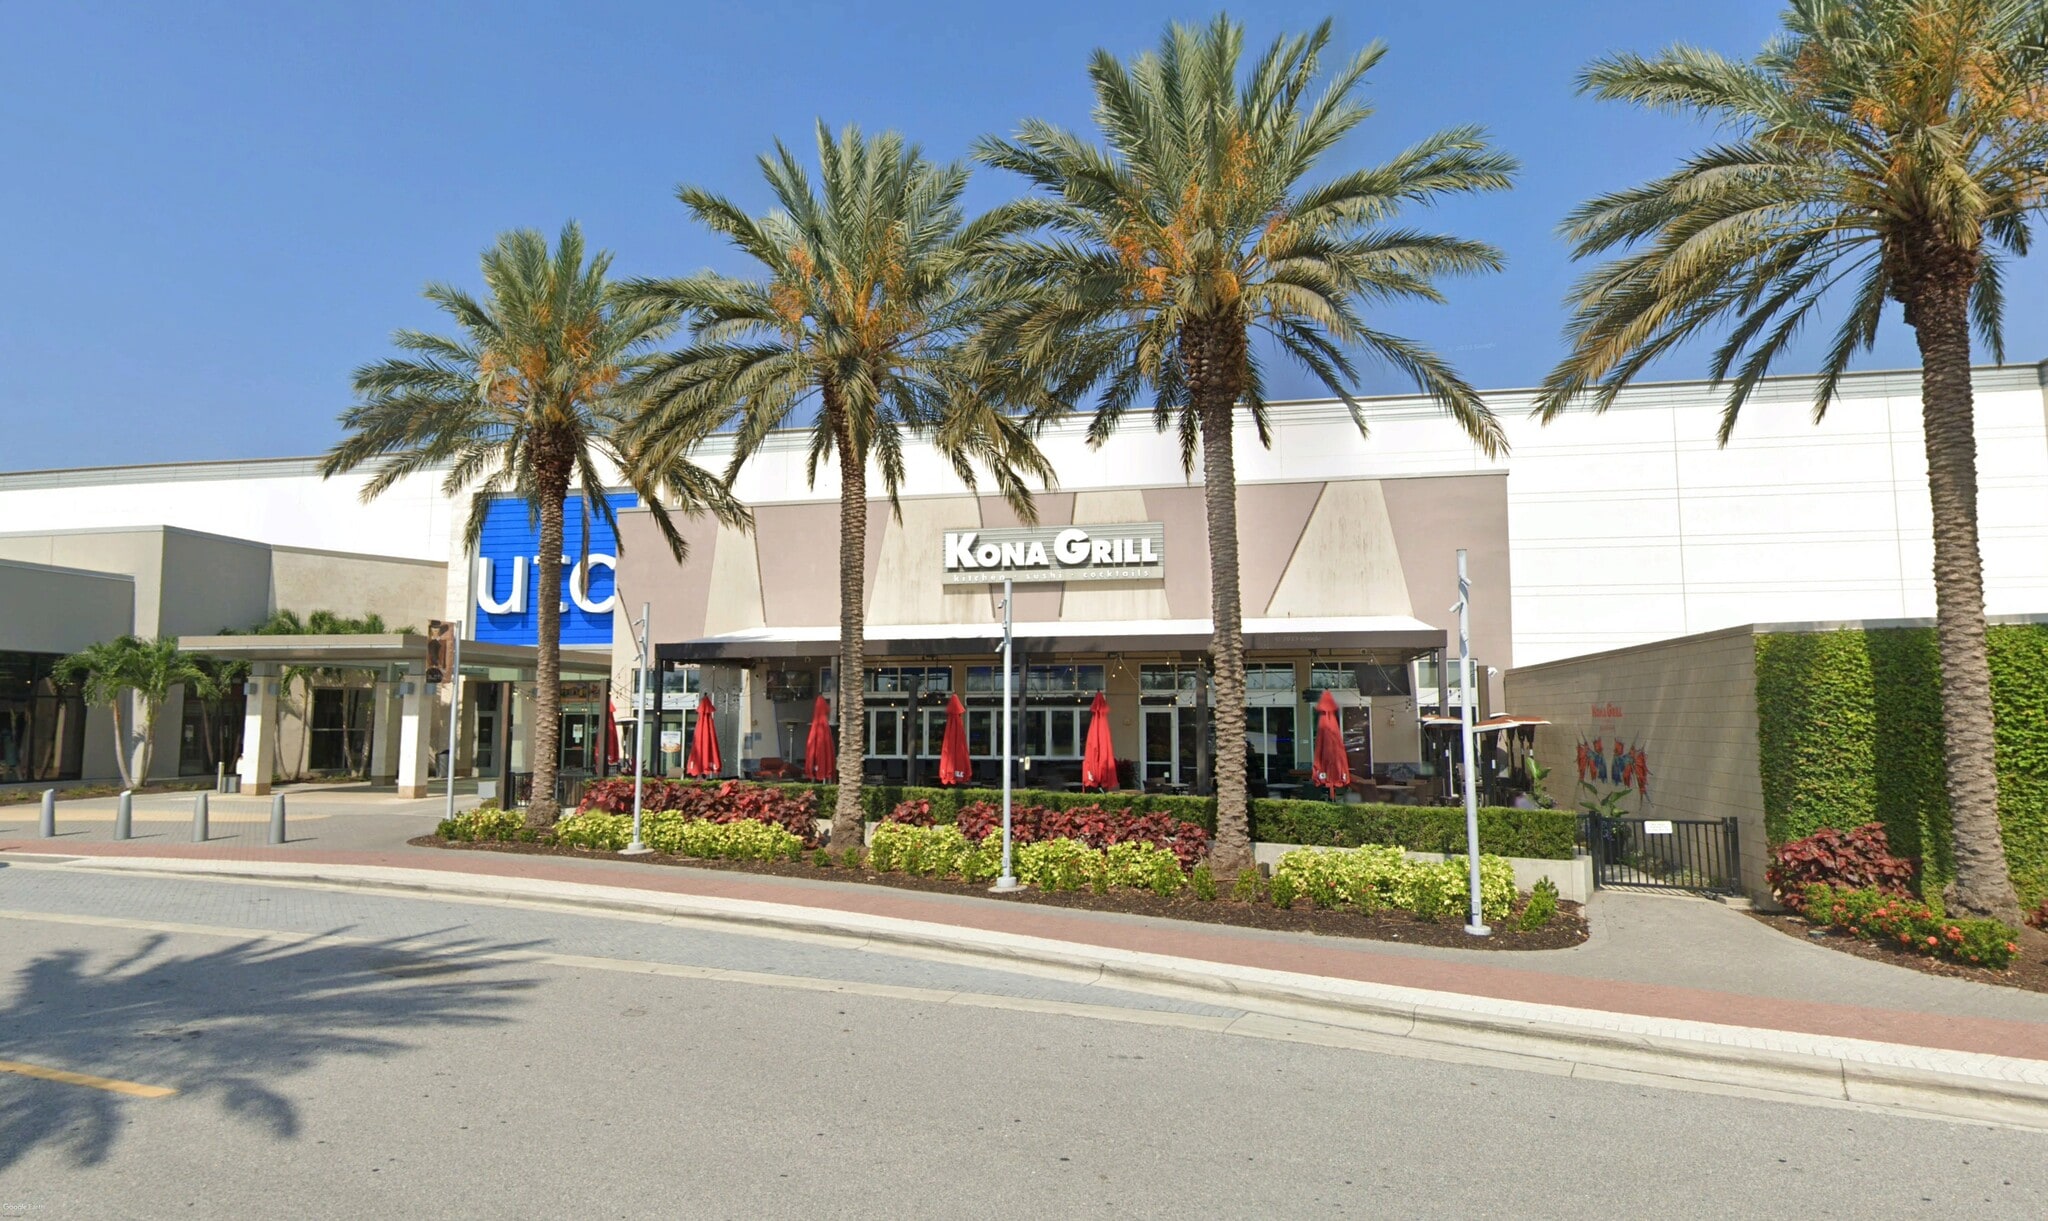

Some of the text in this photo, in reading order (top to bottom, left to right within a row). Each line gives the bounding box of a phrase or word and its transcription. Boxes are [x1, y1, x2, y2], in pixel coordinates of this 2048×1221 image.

[945, 528, 1158, 569] KONA GRILL
[477, 553, 616, 614] uc
[953, 569, 1149, 582] kitchen sushi cocktails
